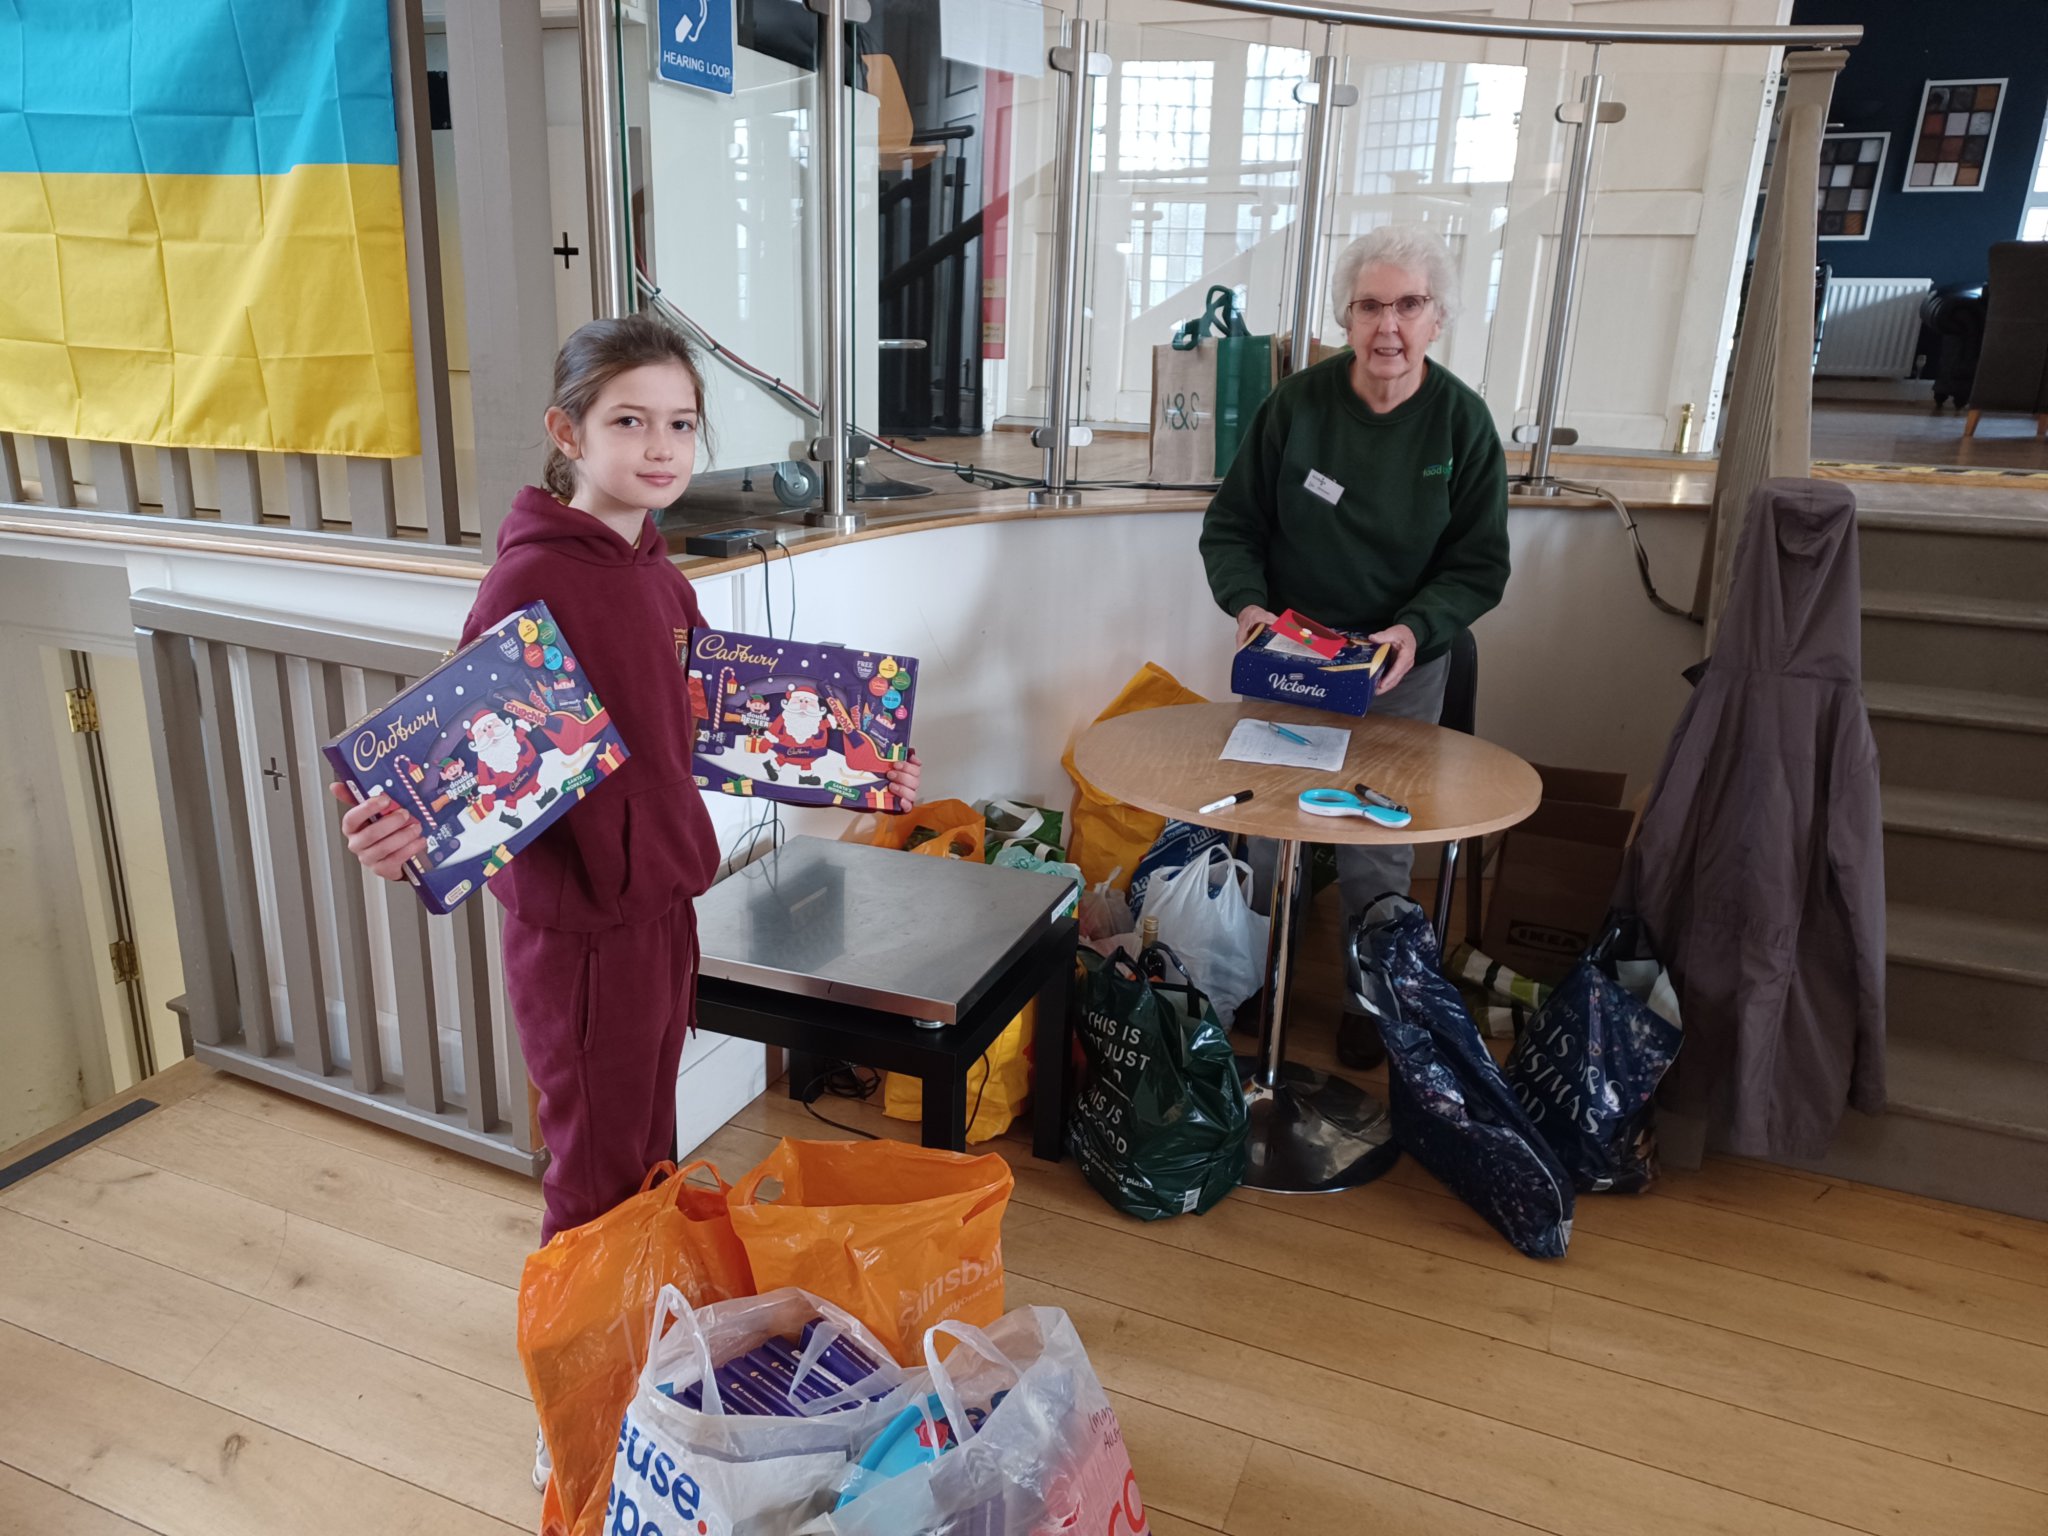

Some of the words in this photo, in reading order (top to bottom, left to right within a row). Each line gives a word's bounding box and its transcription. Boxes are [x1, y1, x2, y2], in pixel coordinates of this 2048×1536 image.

[663, 50, 704, 73] HEARING
[706, 62, 731, 79] LOOP
[1159, 391, 1200, 431] M&S
[696, 634, 779, 673] Cadbury
[1268, 672, 1328, 698] Victoria
[353, 706, 440, 772] Cadbury
[1519, 926, 1576, 947] IKEA
[1088, 1011, 1118, 1036] THIS
[1122, 1025, 1142, 1045] IS
[1104, 1042, 1151, 1071] JUST
